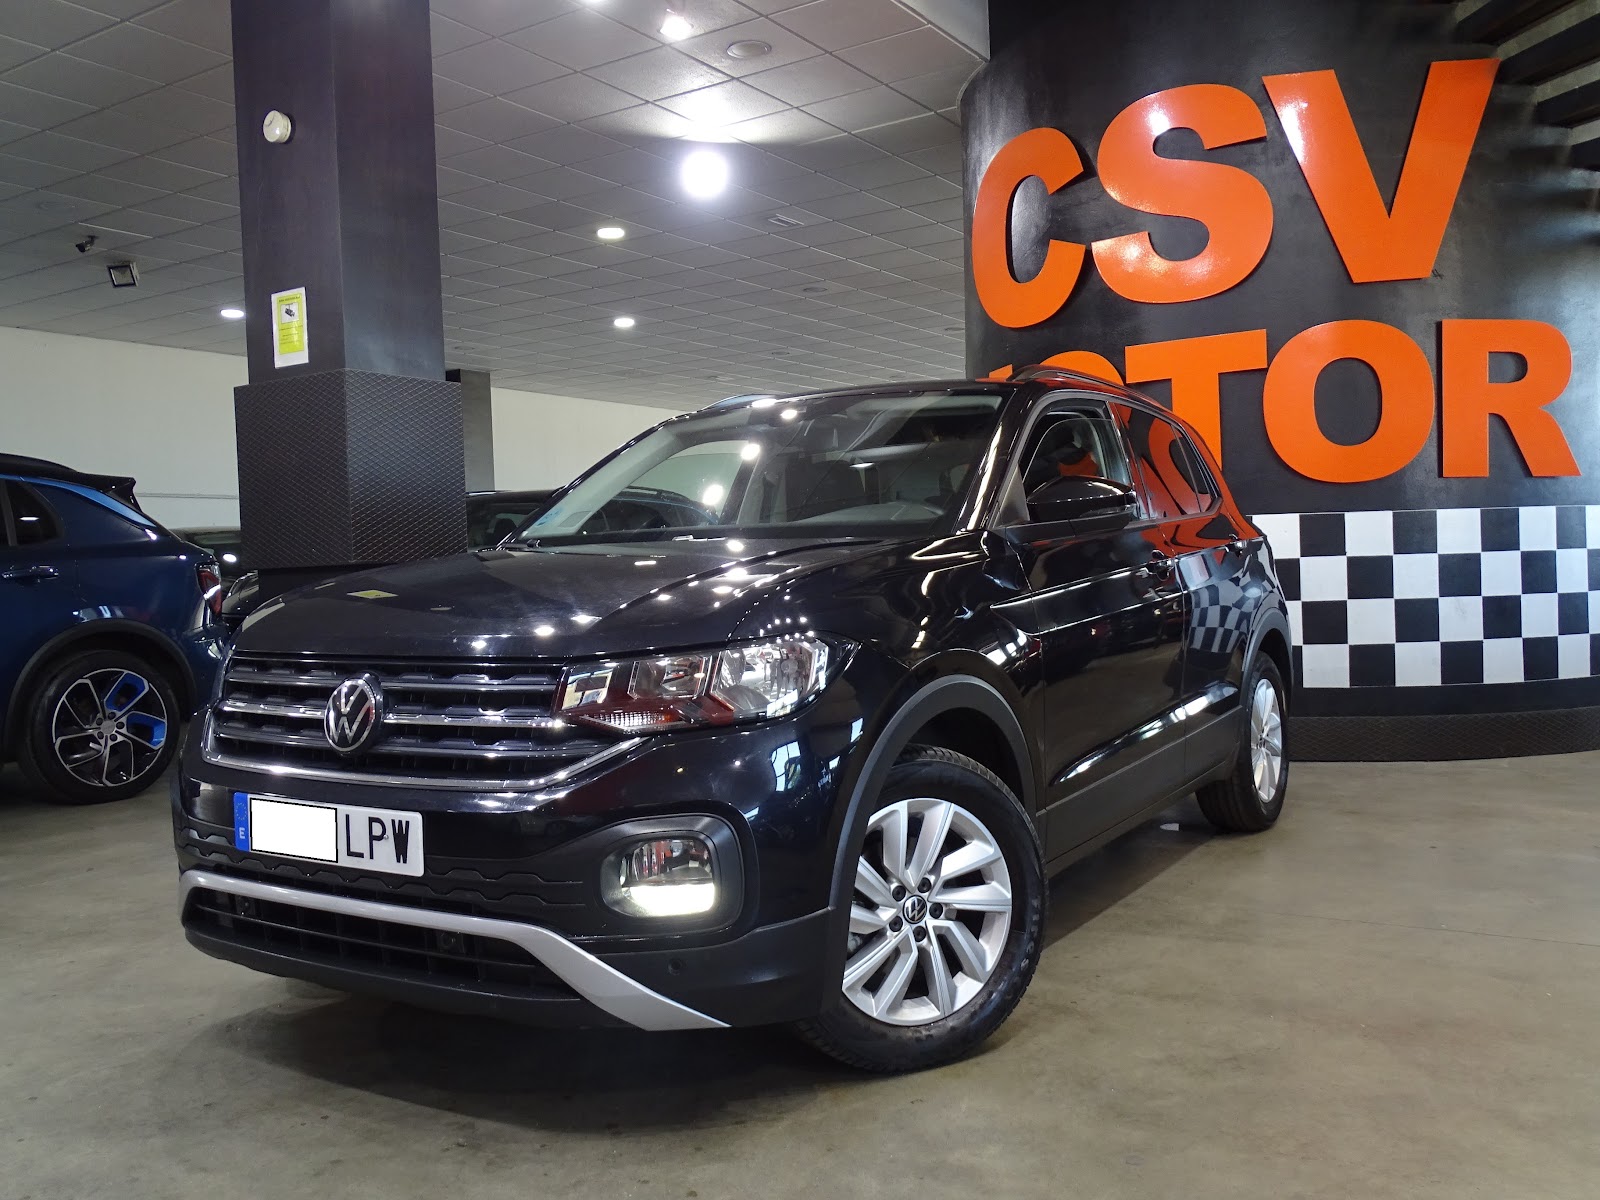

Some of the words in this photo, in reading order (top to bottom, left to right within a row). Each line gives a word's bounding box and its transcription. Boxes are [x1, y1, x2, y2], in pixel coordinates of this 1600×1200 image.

[971, 57, 1500, 329] CSV
[988, 318, 1582, 483] TOR
[238, 826, 247, 840] E
[345, 813, 410, 864] LPW
